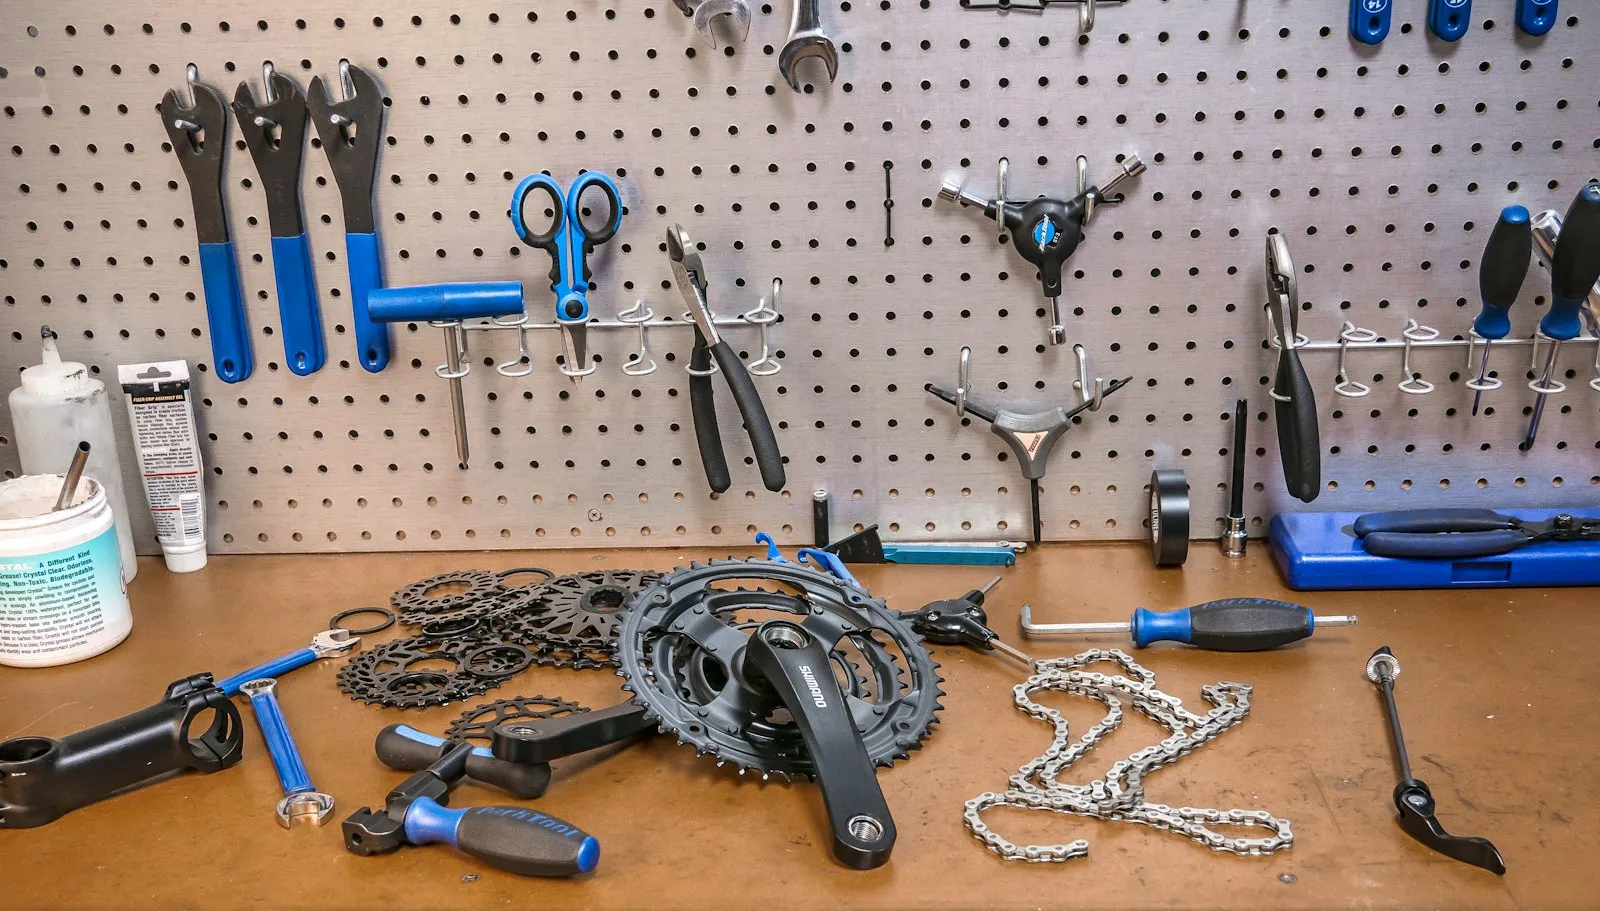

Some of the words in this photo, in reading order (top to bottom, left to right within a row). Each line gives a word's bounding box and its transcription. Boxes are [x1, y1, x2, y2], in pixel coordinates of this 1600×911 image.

[1367, 0, 1382, 9] 14
[23, 569, 47, 579] Crystal
[47, 567, 66, 575] Clear.
[66, 558, 94, 571] Odorless.
[47, 555, 76, 567] Different
[77, 549, 91, 559] Kind
[13, 579, 48, 587] Non-Toxic.
[50, 566, 95, 583] Biodegradable.
[798, 664, 828, 708] SHIMANO
